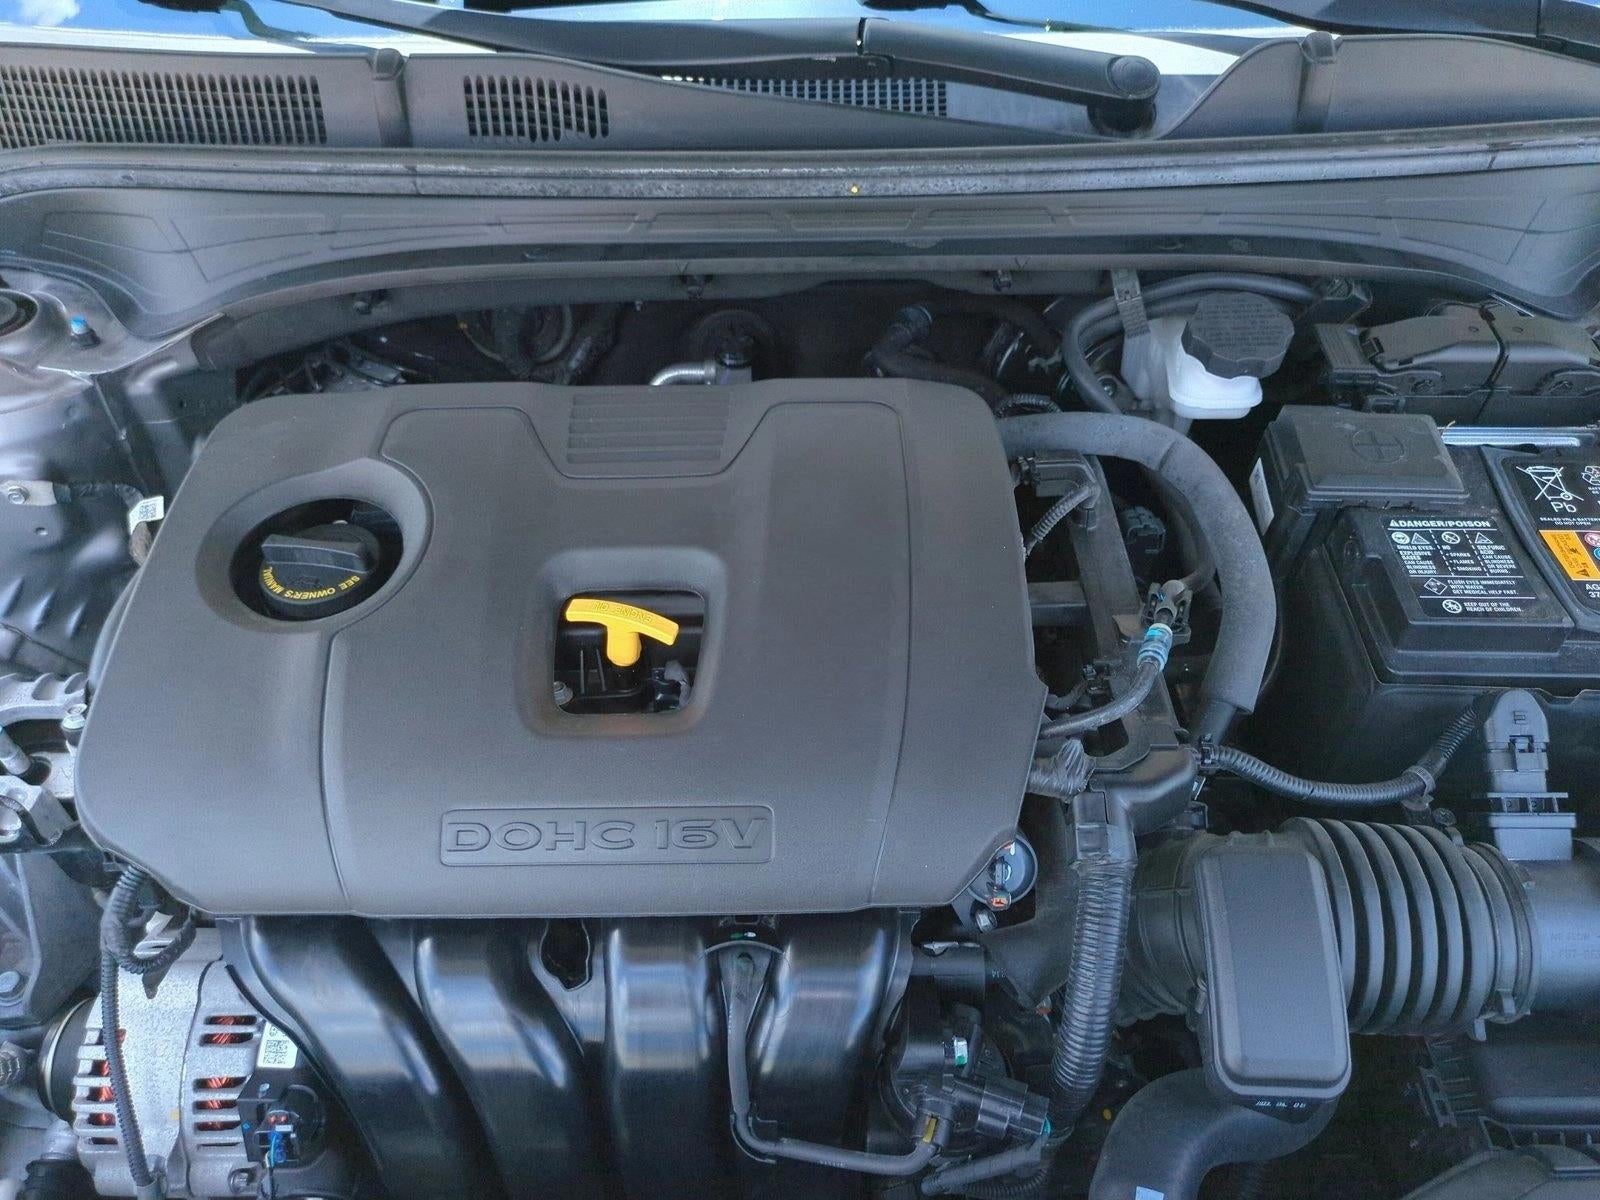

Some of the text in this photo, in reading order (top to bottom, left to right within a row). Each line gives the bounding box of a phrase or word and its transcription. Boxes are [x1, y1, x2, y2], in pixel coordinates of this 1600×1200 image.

[1551, 502, 1577, 513] Pb
[1399, 520, 1491, 528] DANGER/POISON
[338, 575, 361, 591] SEE
[1585, 583, 1600, 591] AG
[284, 587, 336, 600] OWNER'S
[446, 816, 769, 852] DOHC 16V
